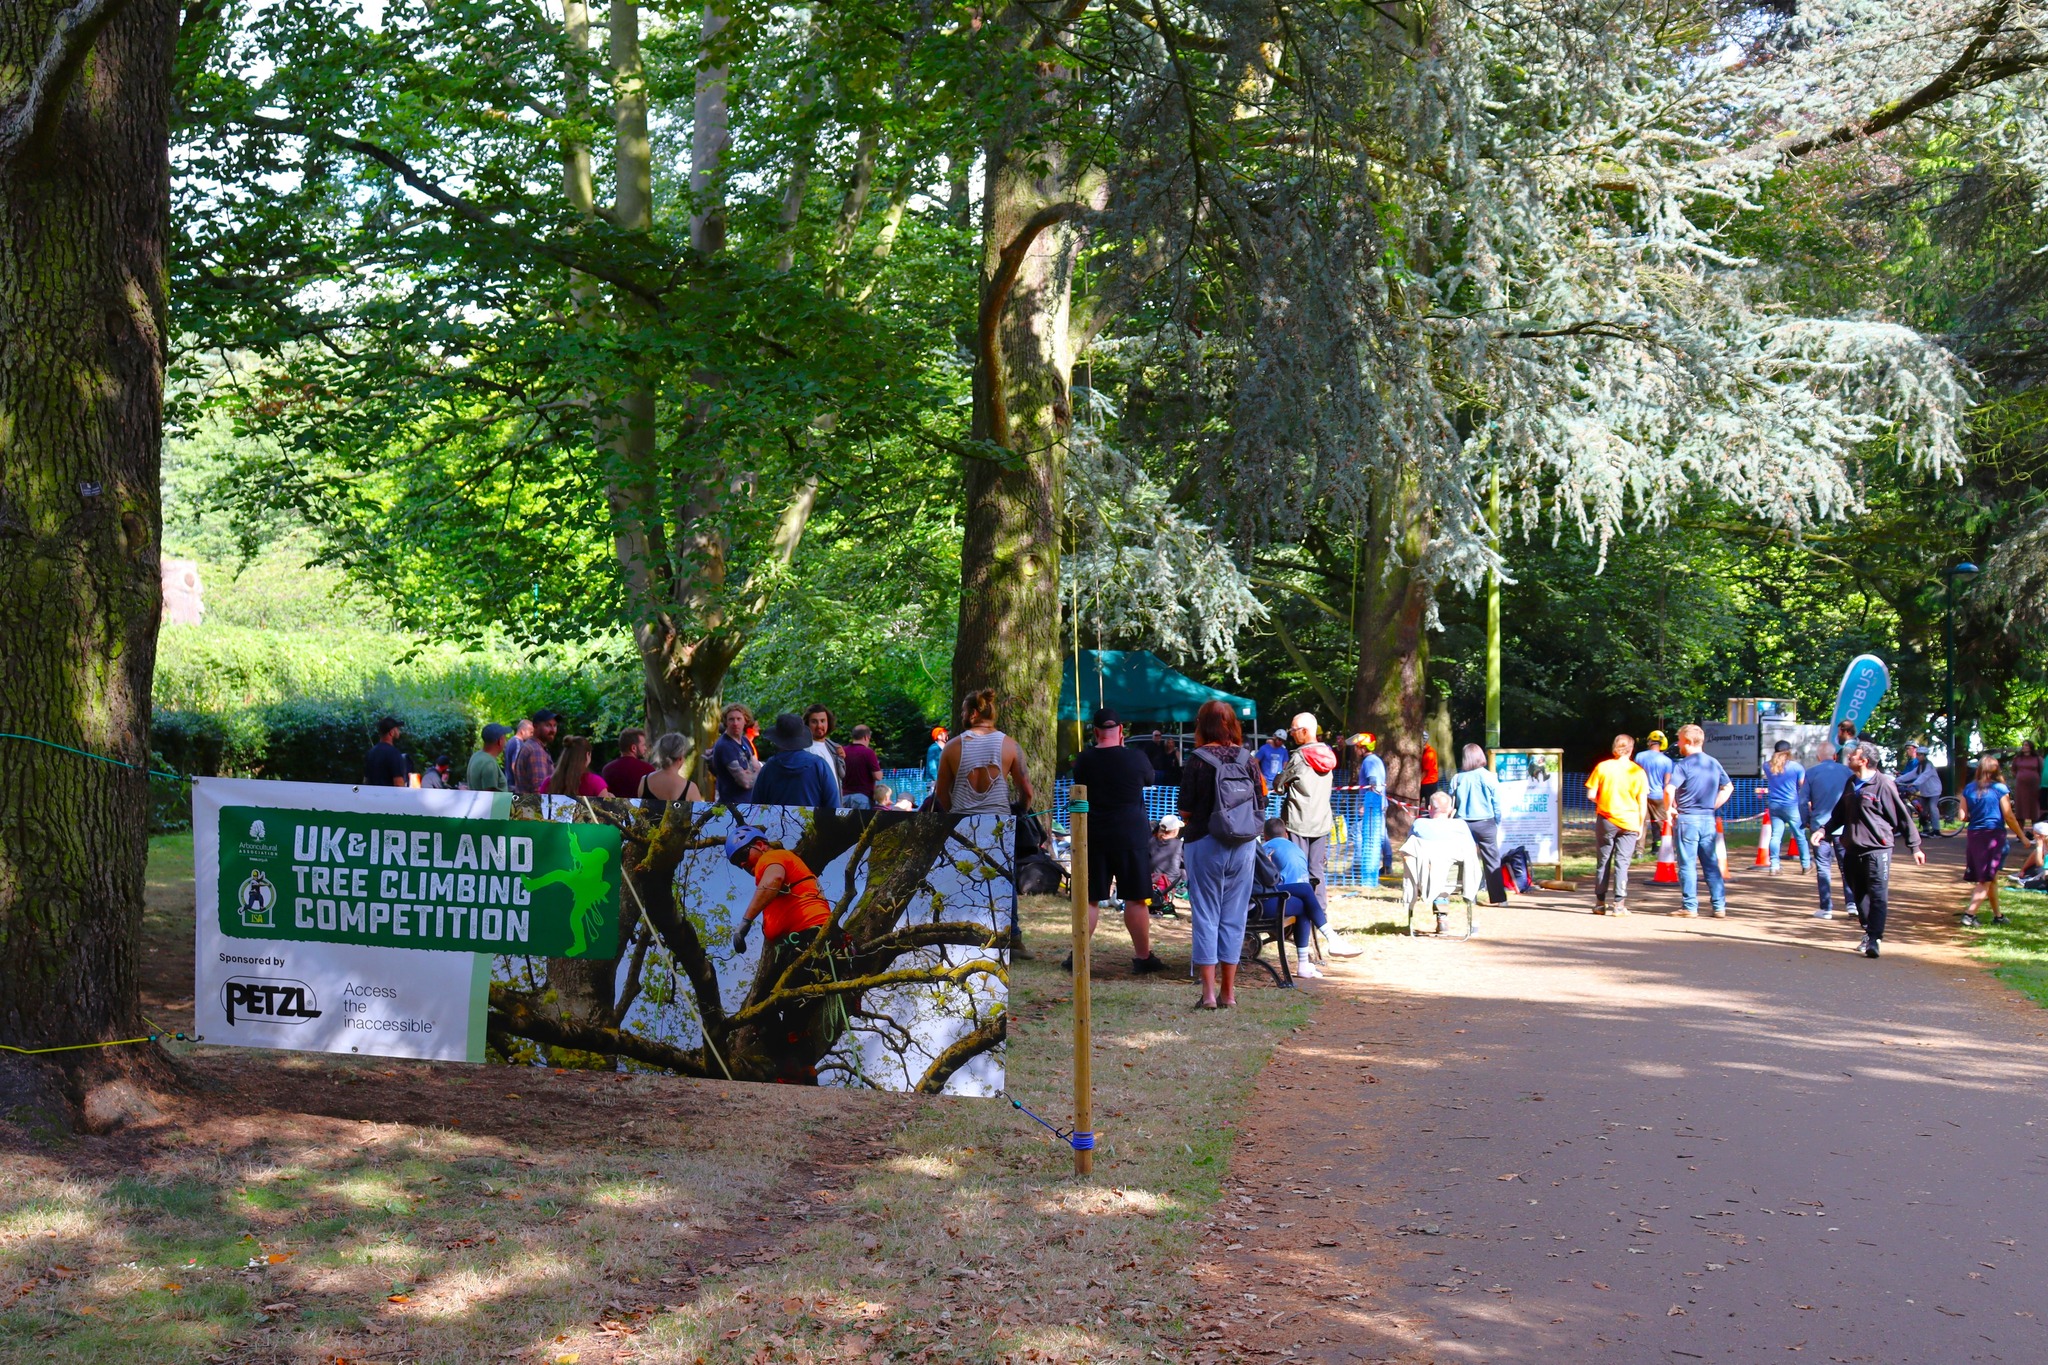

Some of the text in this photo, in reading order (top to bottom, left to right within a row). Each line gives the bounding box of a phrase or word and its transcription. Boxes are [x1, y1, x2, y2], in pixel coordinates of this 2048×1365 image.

[1845, 667, 1875, 721] ORBUS
[238, 842, 278, 852] Arboricultural
[291, 865, 531, 906] TREE CLIMBING
[251, 913, 263, 924] ISA
[294, 897, 530, 942] COMPETITION
[219, 952, 285, 968] Sponsored by
[343, 982, 397, 999] Access
[343, 999, 367, 1014] the
[343, 1015, 433, 1034] inaccessible
